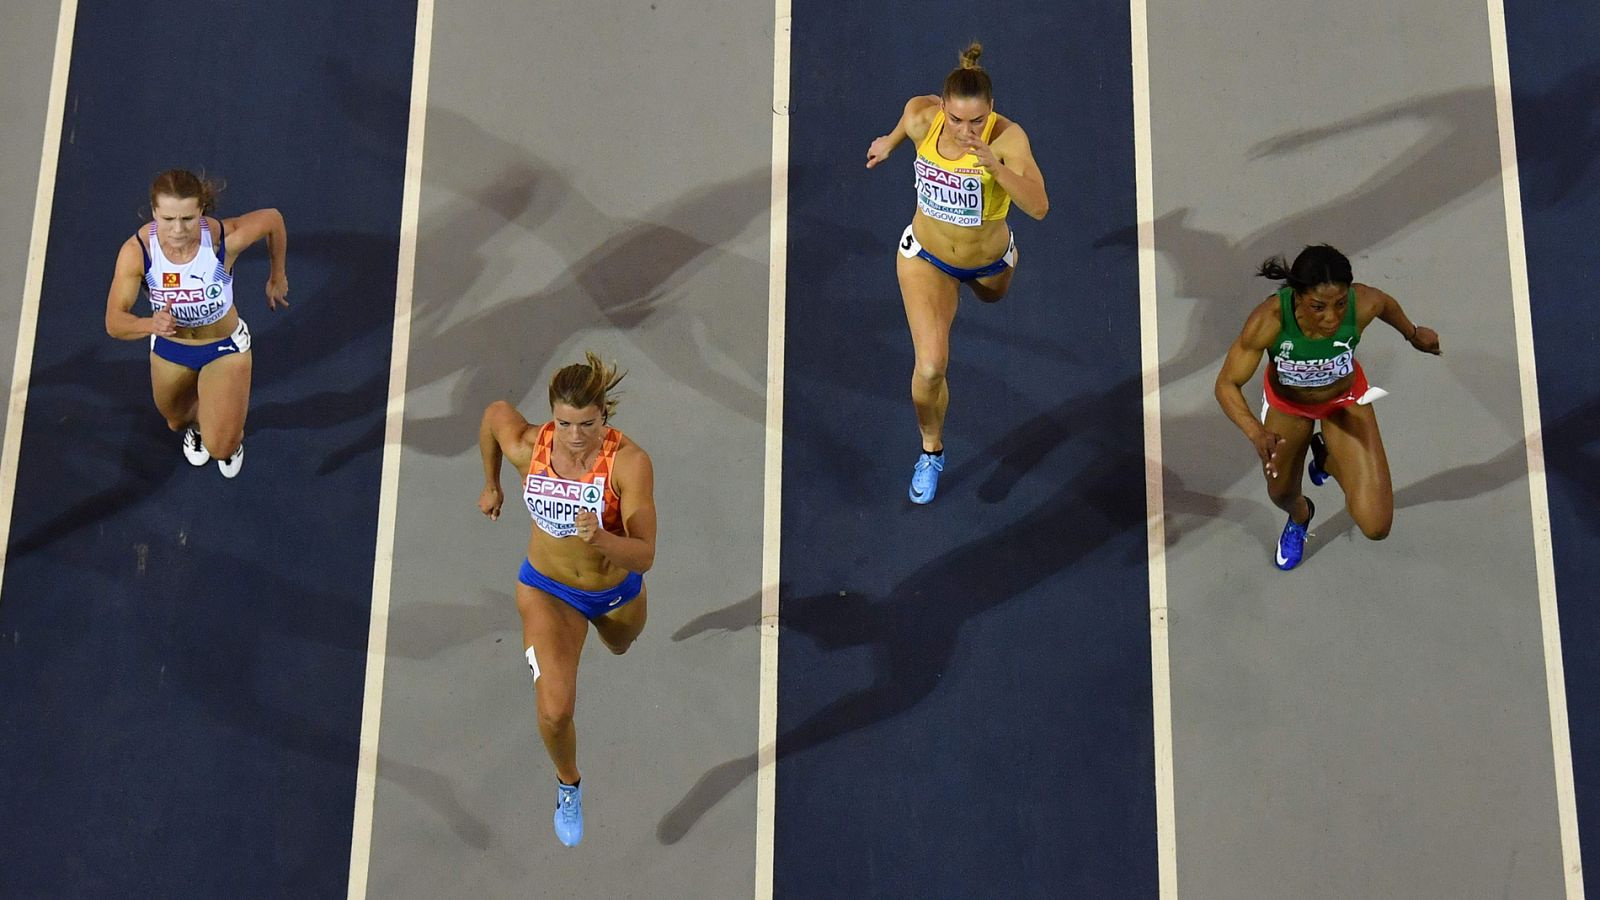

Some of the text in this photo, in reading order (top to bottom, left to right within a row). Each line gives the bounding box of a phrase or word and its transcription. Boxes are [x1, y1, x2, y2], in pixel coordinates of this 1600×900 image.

[916, 163, 960, 188] SPAR
[958, 217, 979, 225] 2019
[901, 234, 914, 250] 5
[152, 290, 203, 302] SPAR
[153, 300, 224, 320] RNNINGEN
[1280, 361, 1334, 373] SPAR
[529, 480, 580, 499] SPAR
[536, 517, 577, 536] GLASGOW
